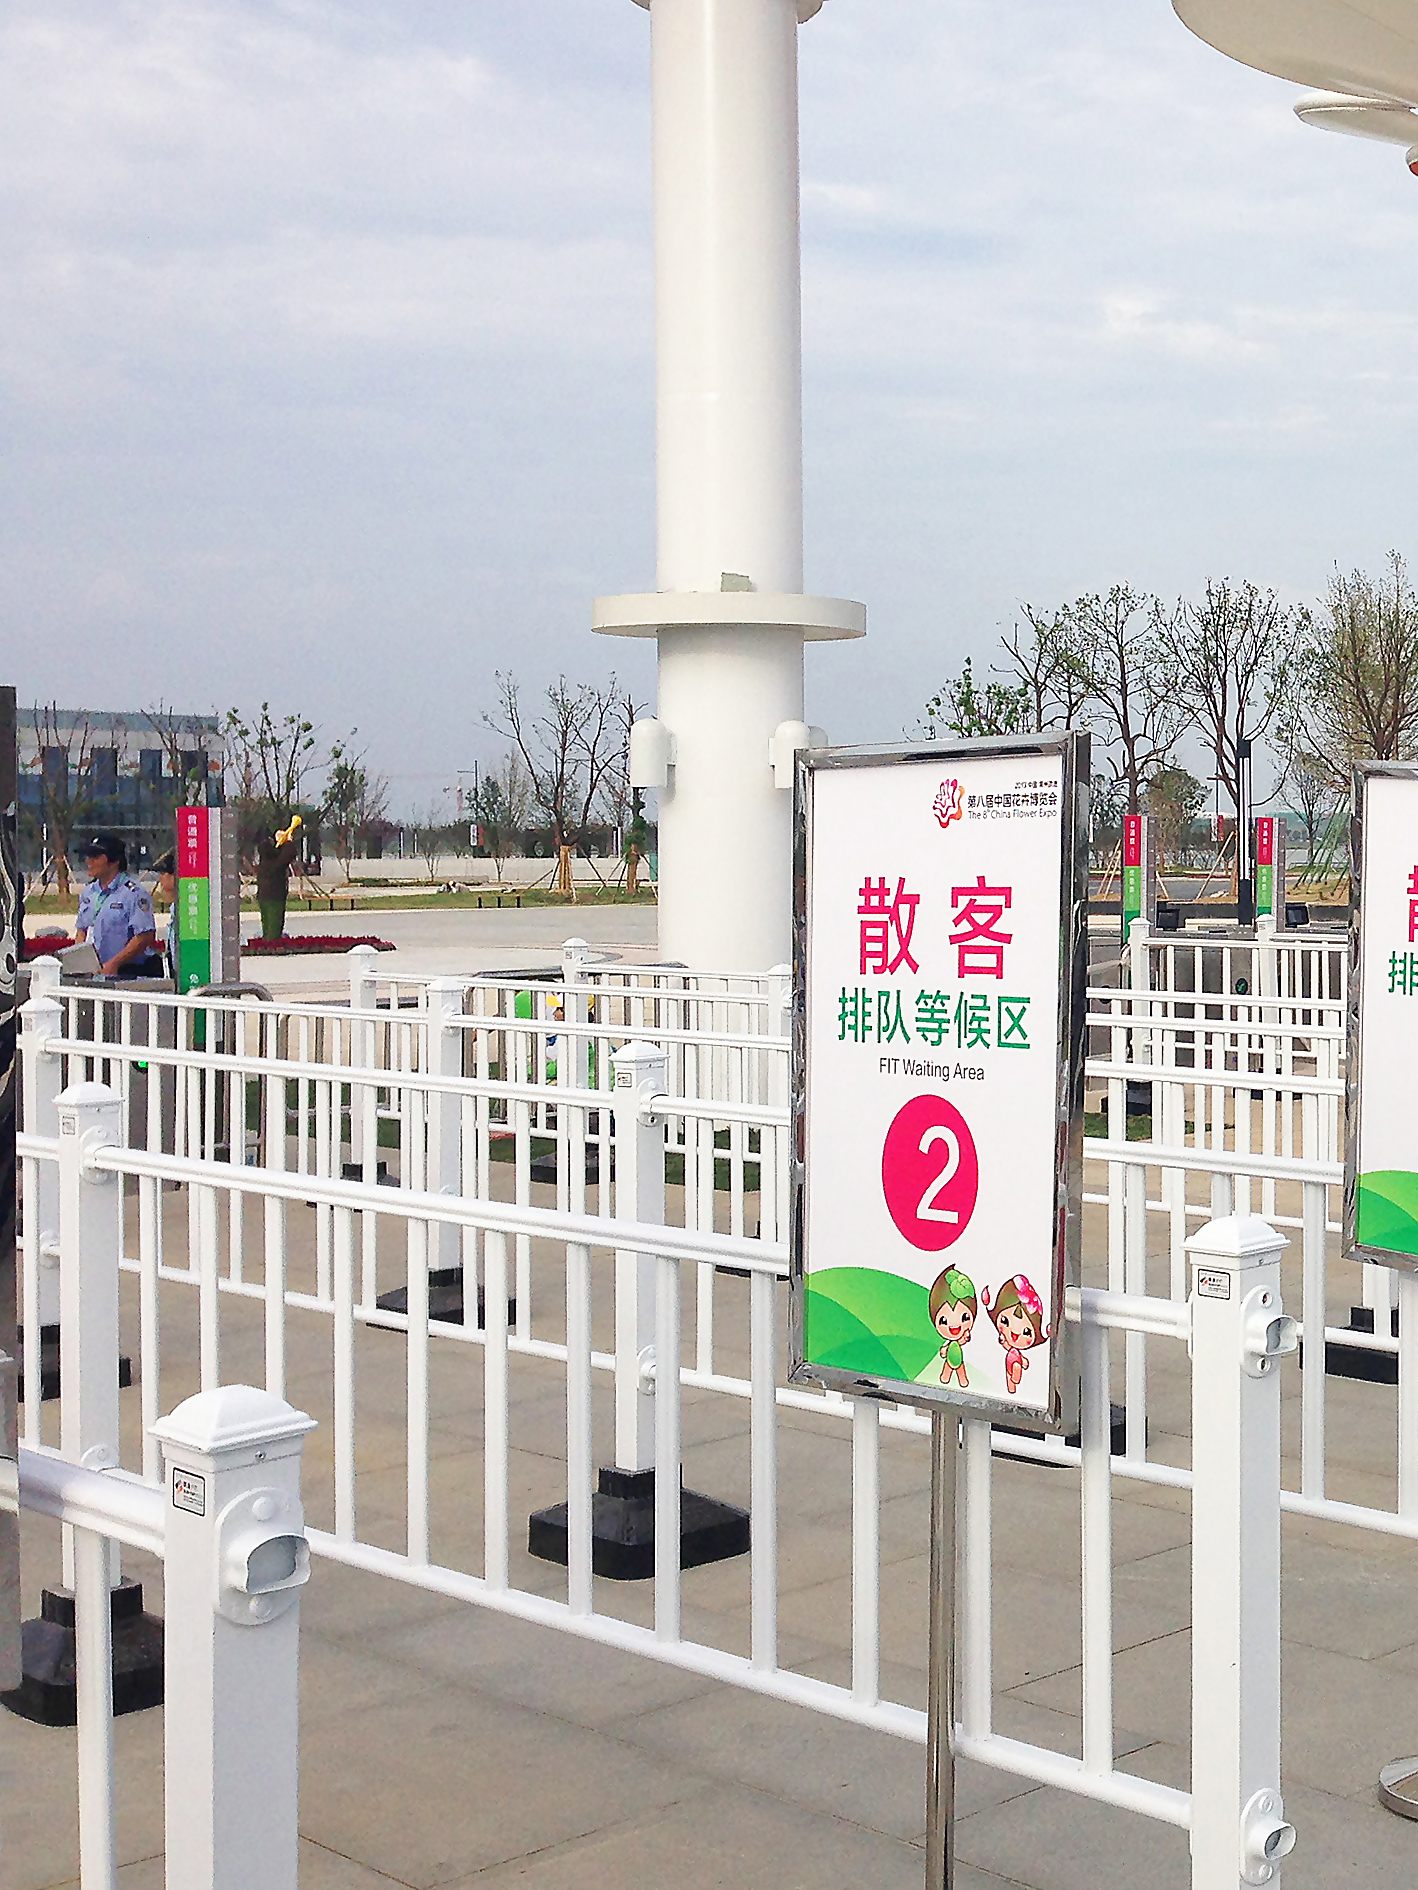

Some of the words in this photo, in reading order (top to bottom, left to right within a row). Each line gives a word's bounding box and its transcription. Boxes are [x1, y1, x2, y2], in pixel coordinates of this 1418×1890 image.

[968, 792, 1057, 808] 第八届中国花卉博览会
[968, 810, 981, 819] The
[991, 809, 1011, 819] China
[1039, 808, 1057, 819] Expo
[857, 876, 1013, 979] 散客
[838, 987, 1031, 1050] 排队等候区
[880, 1058, 900, 1074] FIT
[903, 1059, 950, 1082] Waiting
[953, 1063, 985, 1080] Area
[916, 1125, 961, 1224] 2
